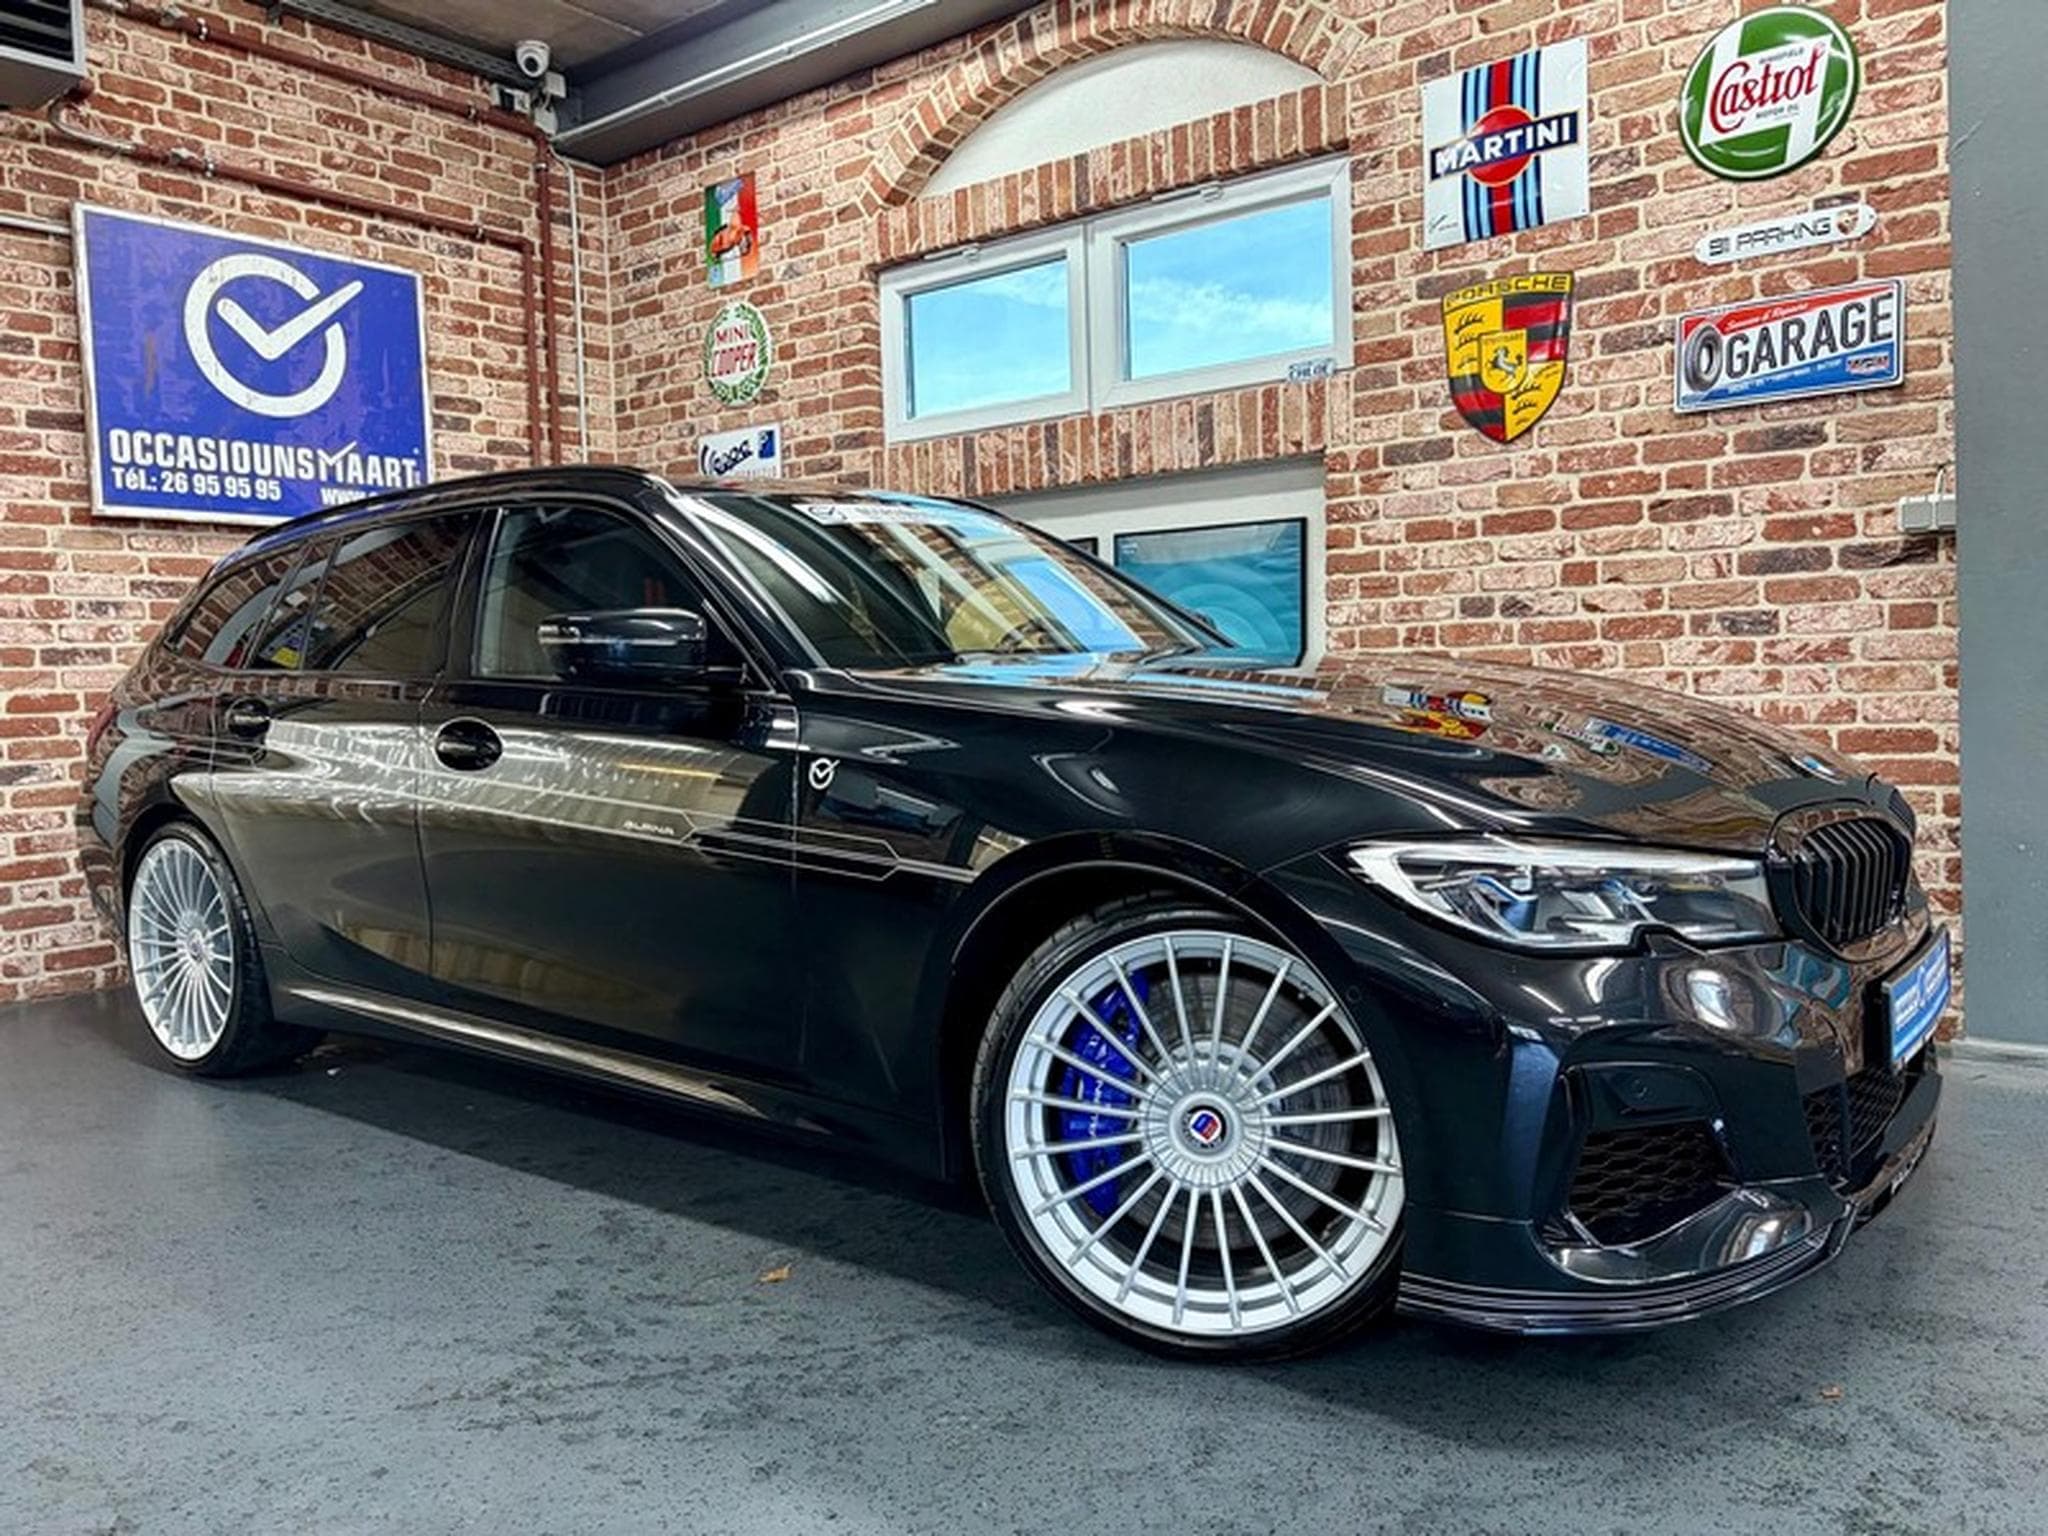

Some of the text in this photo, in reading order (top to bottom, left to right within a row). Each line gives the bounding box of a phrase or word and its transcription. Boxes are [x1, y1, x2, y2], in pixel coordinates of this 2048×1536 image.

[1709, 42, 1825, 133] Castrol
[1436, 118, 1573, 176] MARTINI
[1736, 217, 1832, 250] PARKING
[1447, 275, 1568, 307] PORSCHE
[715, 323, 751, 346] MINI
[1726, 292, 1894, 379] GARAGE
[711, 342, 758, 378] COOPER
[109, 429, 416, 488] OCCASIOUNSMAART
[701, 439, 754, 475] Vespa
[160, 469, 189, 494] 26
[193, 472, 220, 497] 95
[224, 475, 251, 499] 95
[255, 477, 282, 501] 95
